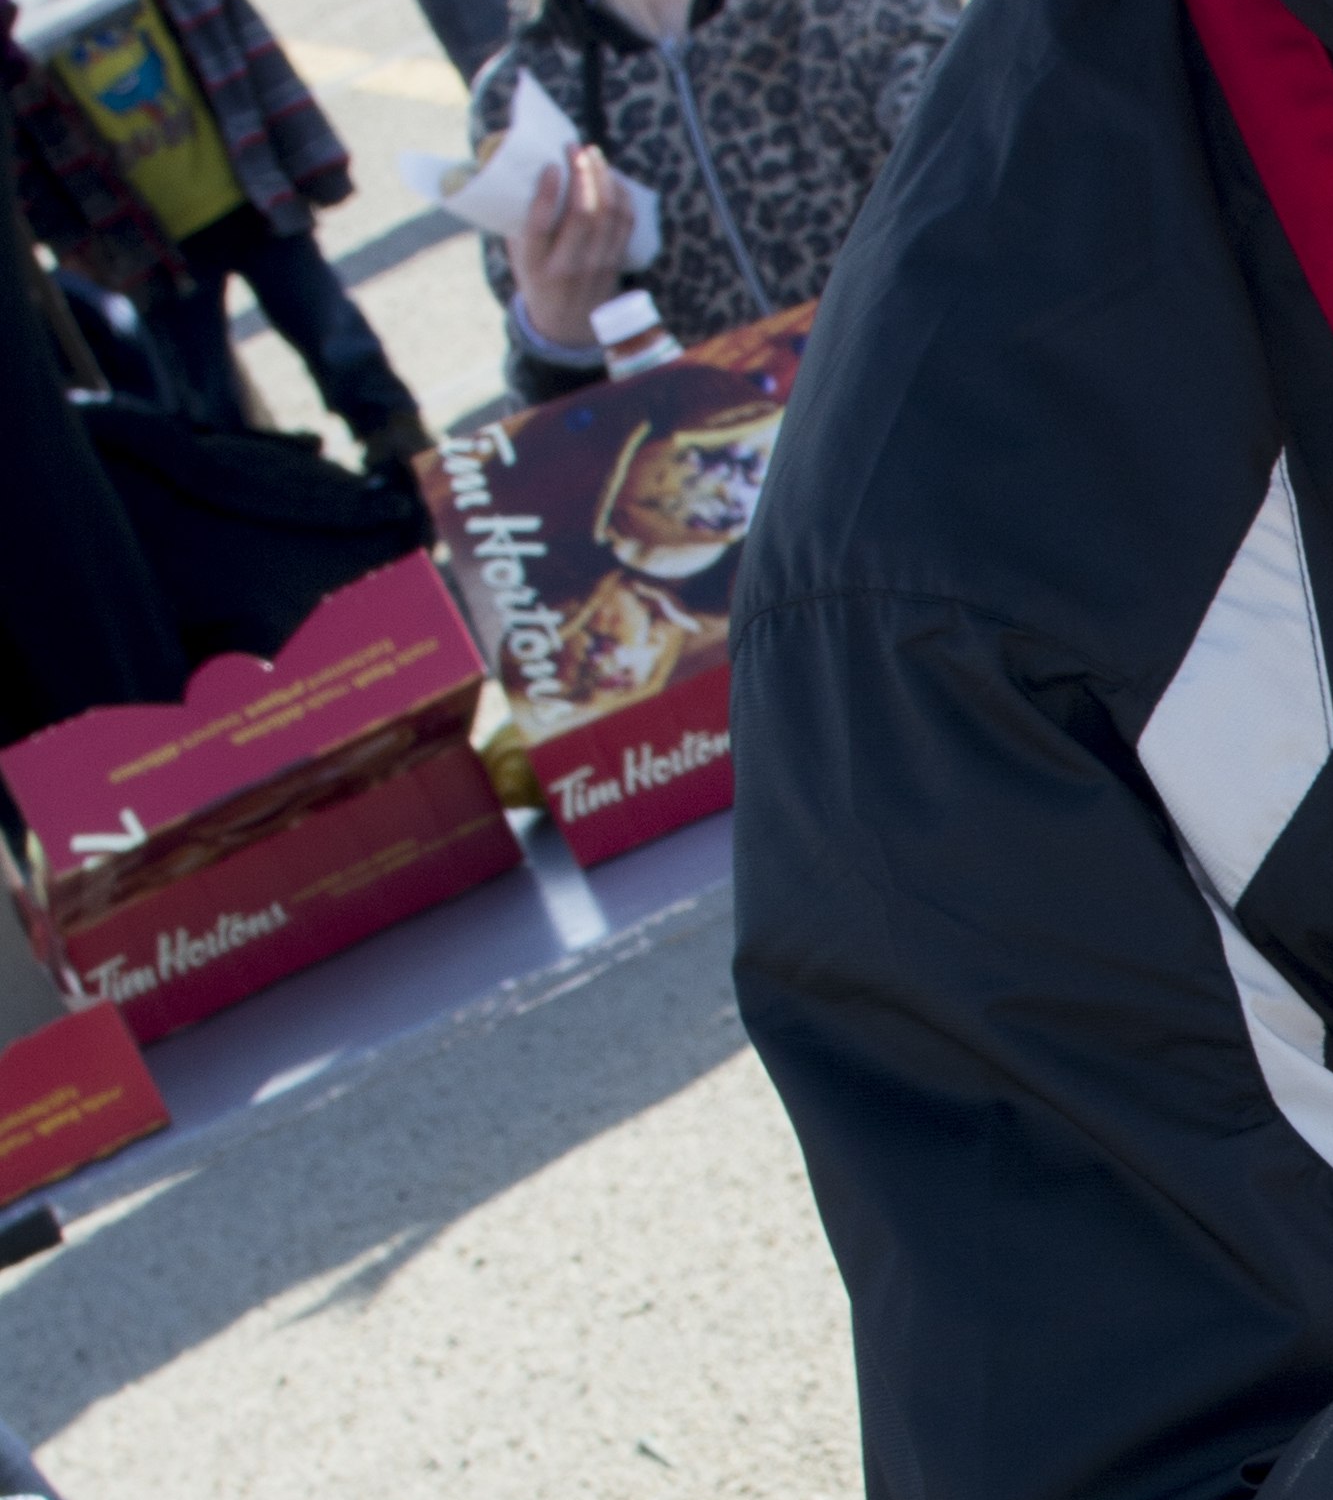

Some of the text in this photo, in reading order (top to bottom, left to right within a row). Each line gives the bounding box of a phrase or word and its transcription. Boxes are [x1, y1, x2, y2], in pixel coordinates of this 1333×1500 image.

[548, 766, 622, 822] Tim
[87, 900, 290, 1003] Tim Hortons
